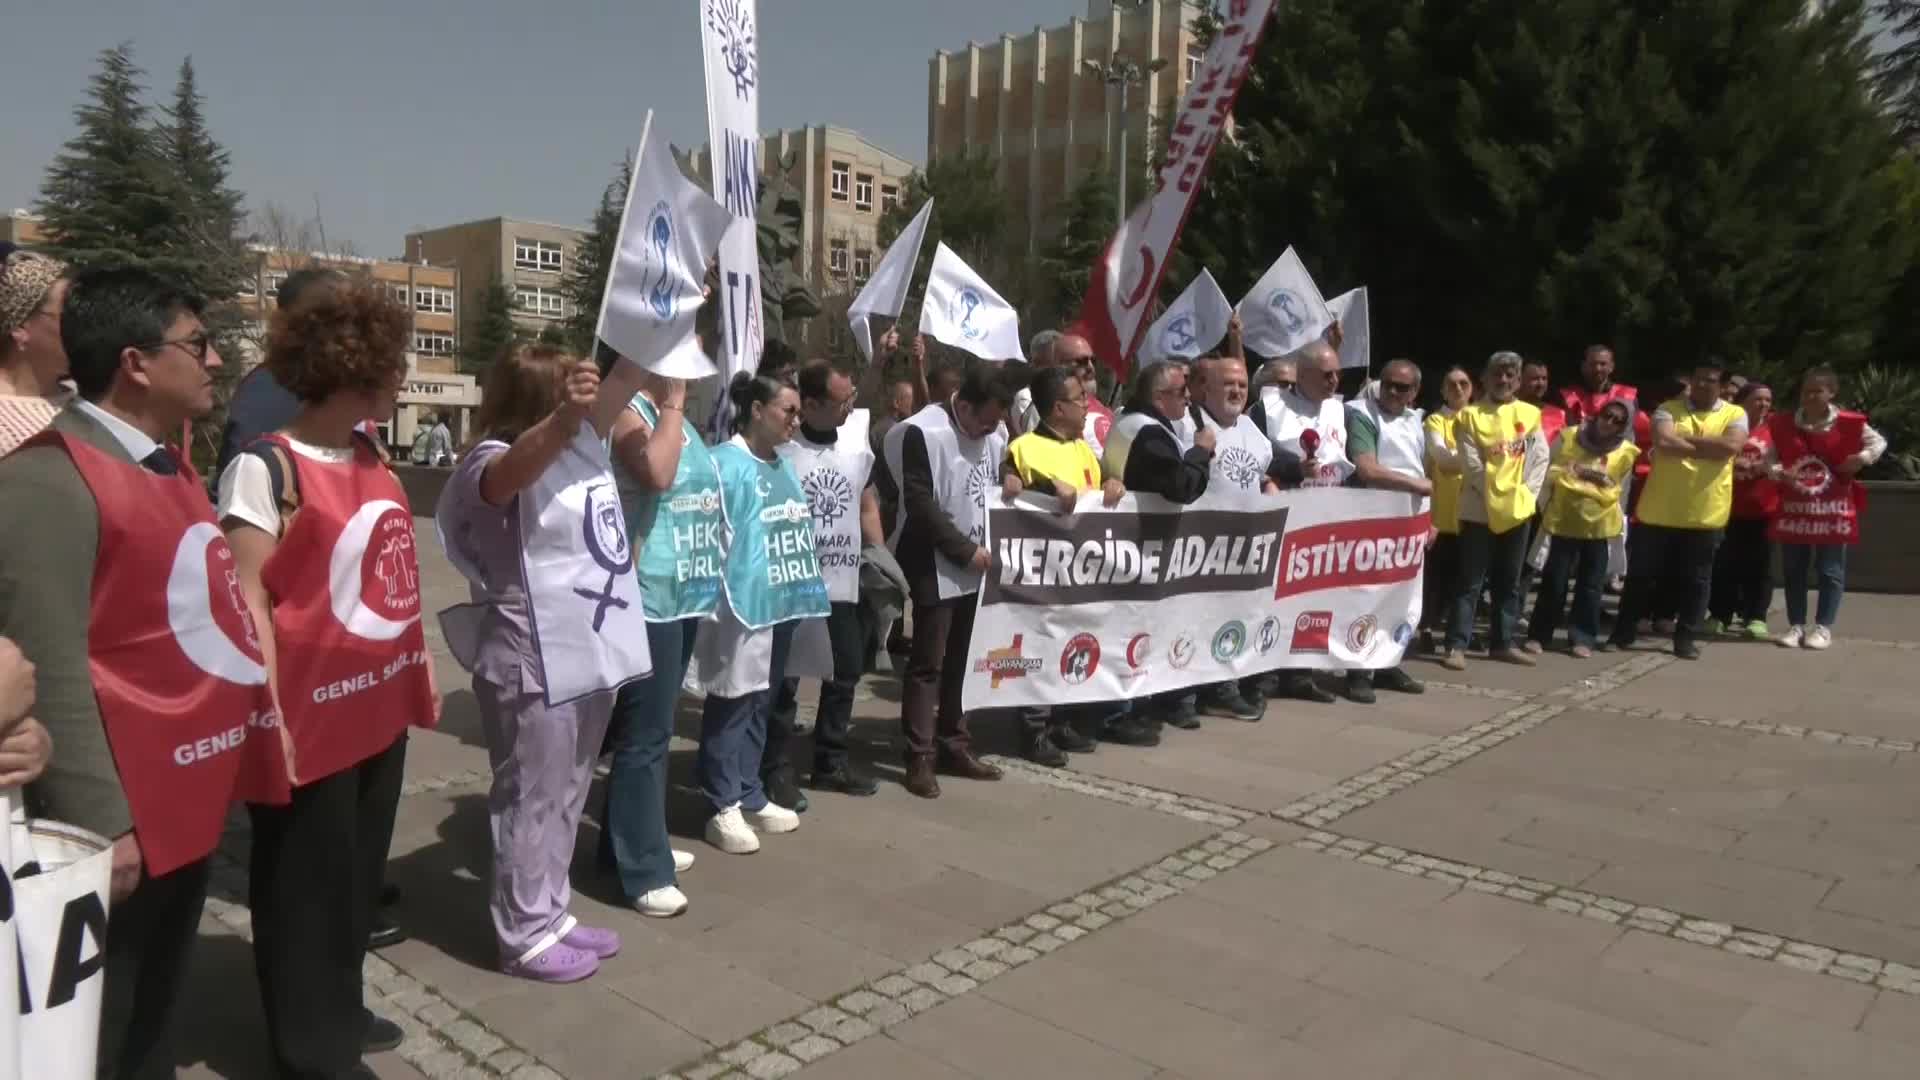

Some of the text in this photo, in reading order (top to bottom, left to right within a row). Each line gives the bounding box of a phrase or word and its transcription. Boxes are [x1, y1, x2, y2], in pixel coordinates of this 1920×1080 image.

[725, 128, 757, 217] ANK
[763, 523, 817, 558] HEKİ
[999, 527, 1429, 587] VERGİDE ADALET İSTİYORUZ
[767, 554, 822, 586] BİRLİ
[312, 671, 379, 704] GENEL
[174, 722, 247, 766] GENEL
